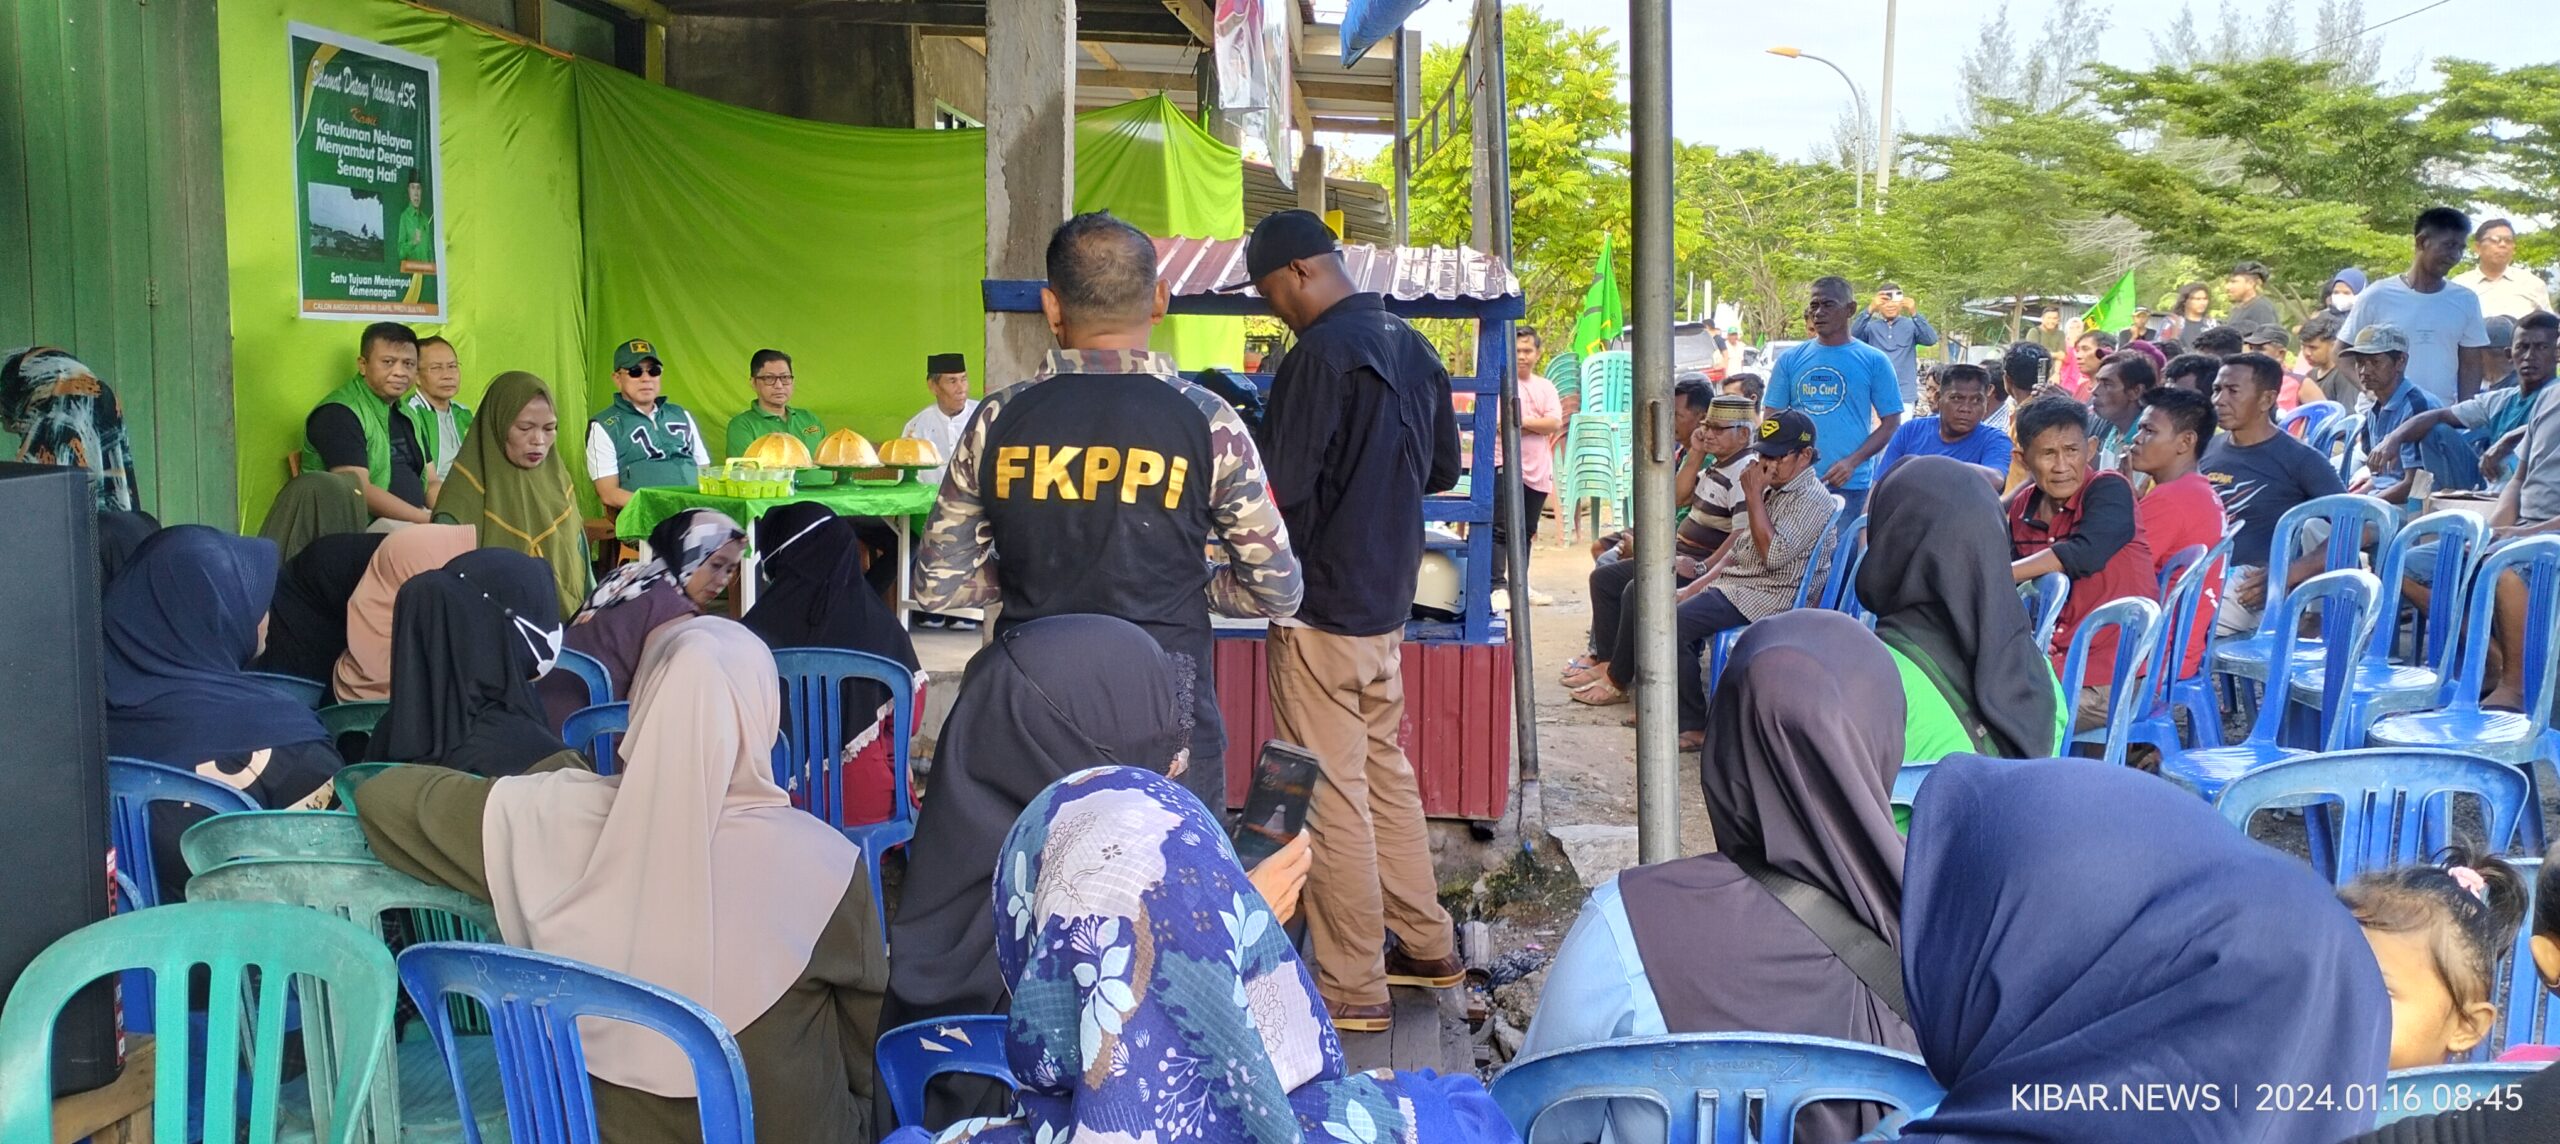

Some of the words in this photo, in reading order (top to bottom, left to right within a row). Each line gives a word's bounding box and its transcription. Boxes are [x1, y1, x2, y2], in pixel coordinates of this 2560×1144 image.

[312, 60, 341, 92] Selamat
[343, 66, 369, 106] Datang
[396, 80, 416, 110] ASR
[316, 117, 370, 142] Kerukunan
[373, 129, 412, 151] Nelayan
[315, 135, 375, 158] Menyambut
[376, 147, 414, 169] Dengan
[337, 159, 374, 183] Senang
[376, 165, 397, 183] Hati
[330, 271, 347, 284] Satu
[349, 273, 372, 287] Tujuan
[374, 275, 411, 288] Menjemput
[349, 285, 396, 299] Kemenangan
[1802, 382, 1817, 398] Rip
[1818, 383, 1838, 396] Curl
[996, 444, 1187, 509] FKPPI
